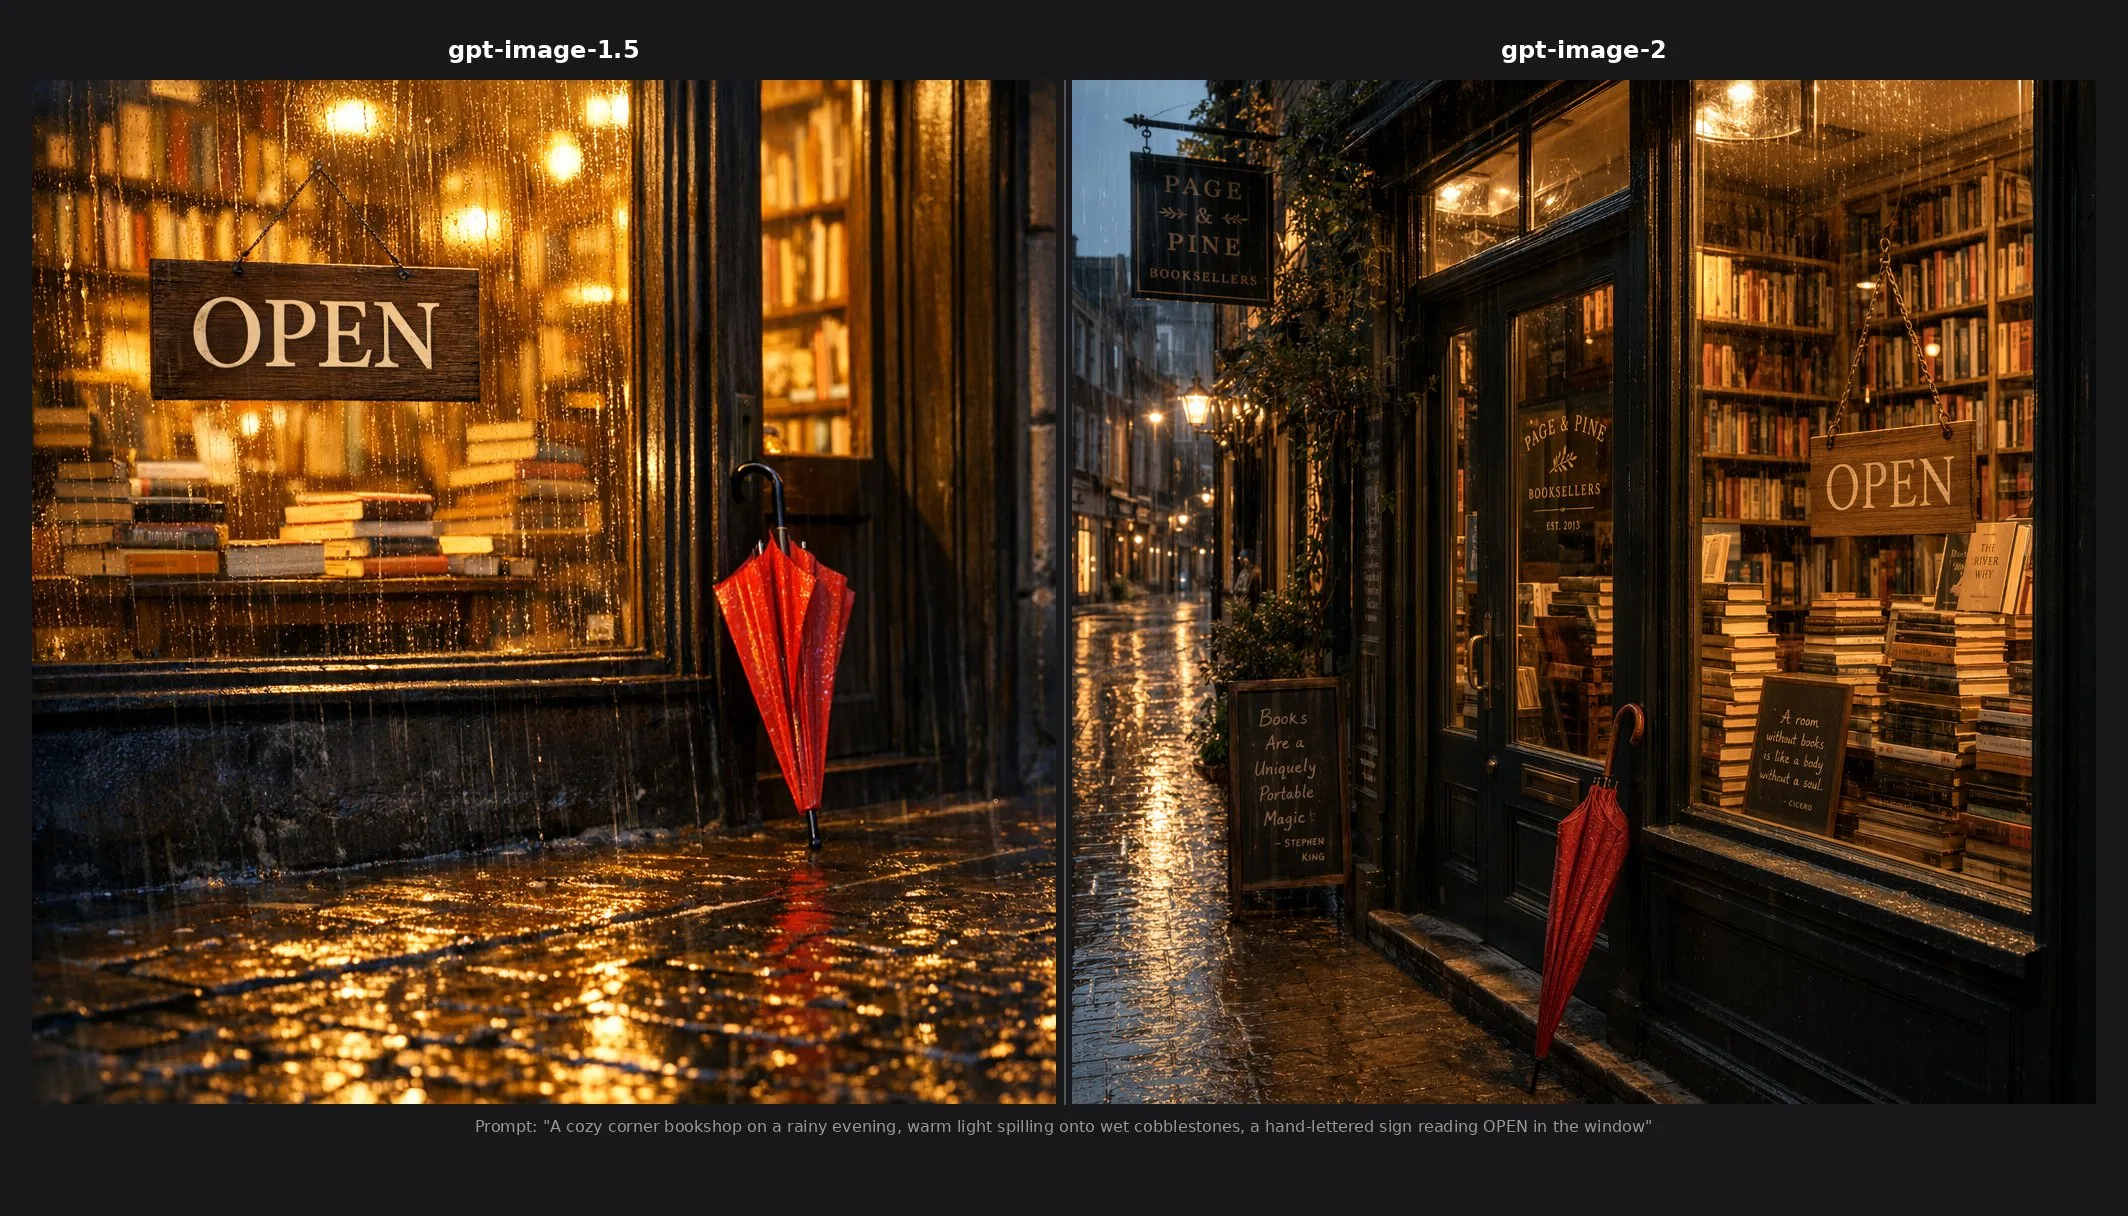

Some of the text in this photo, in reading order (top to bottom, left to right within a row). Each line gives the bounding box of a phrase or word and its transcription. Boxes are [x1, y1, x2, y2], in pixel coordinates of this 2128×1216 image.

[1164, 174, 1242, 200] PAGE
[1195, 207, 1213, 224] &
[1167, 232, 1241, 256] PINE
[1149, 267, 1258, 286] BOOKSELLERS
[193, 296, 440, 370] OPEN
[1524, 414, 1607, 451] PAGE & PINE
[1528, 482, 1601, 500] BOOKSELLERS
[1826, 455, 1955, 511] OPEN
[1546, 520, 1581, 531] EST. 2013
[1981, 543, 1996, 553] THE
[1973, 556, 1999, 566] RIVER
[1974, 570, 1995, 580] WHY
[1259, 708, 1308, 727] Books
[1779, 708, 1820, 729] A room
[1265, 734, 1305, 751] Are a
[1766, 730, 1825, 750] without books
[1254, 757, 1317, 780] Uniquely
[1763, 749, 1824, 776] is like a body
[1760, 769, 1823, 792] without a soul.
[1259, 784, 1315, 802] Portable
[1301, 853, 1326, 863] KING
